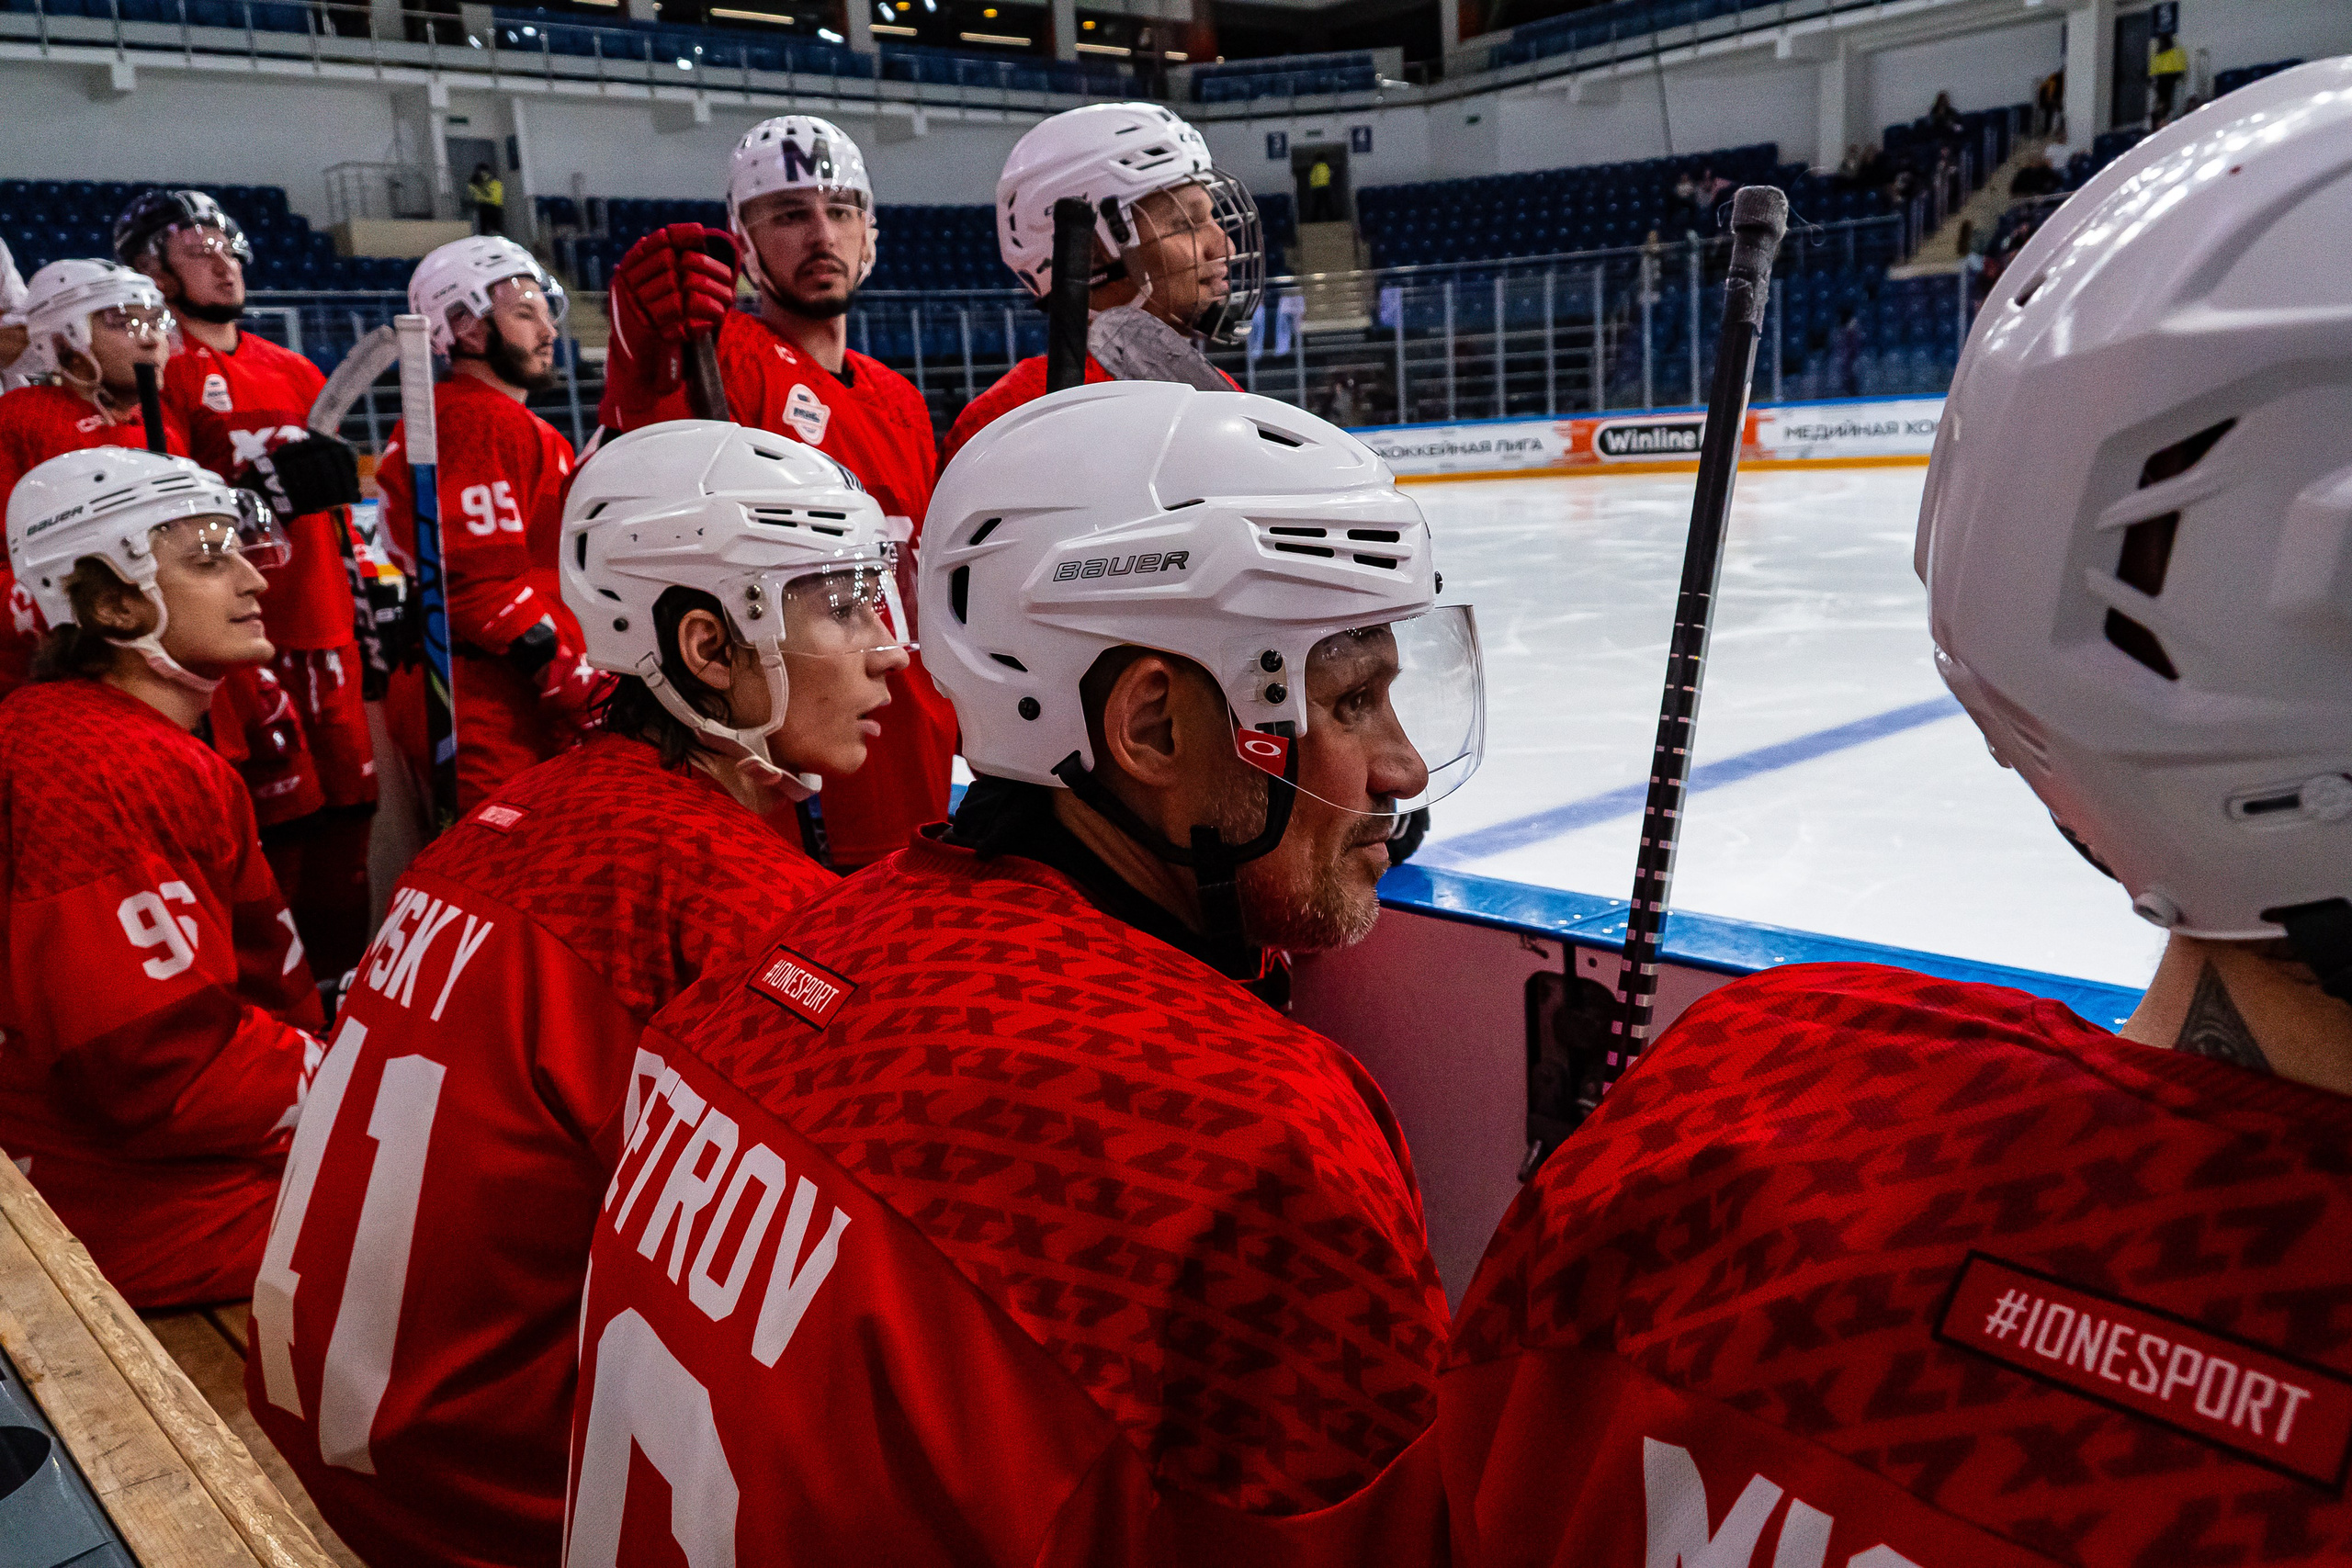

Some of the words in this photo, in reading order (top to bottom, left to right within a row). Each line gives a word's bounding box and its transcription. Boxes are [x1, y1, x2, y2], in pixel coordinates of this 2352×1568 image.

[782, 137, 833, 182] M
[1605, 426, 1697, 453] Winline
[1785, 420, 1900, 441] МЕДИЙНАЯ
[1495, 436, 1544, 453] ЛИГА
[461, 480, 524, 536] 95
